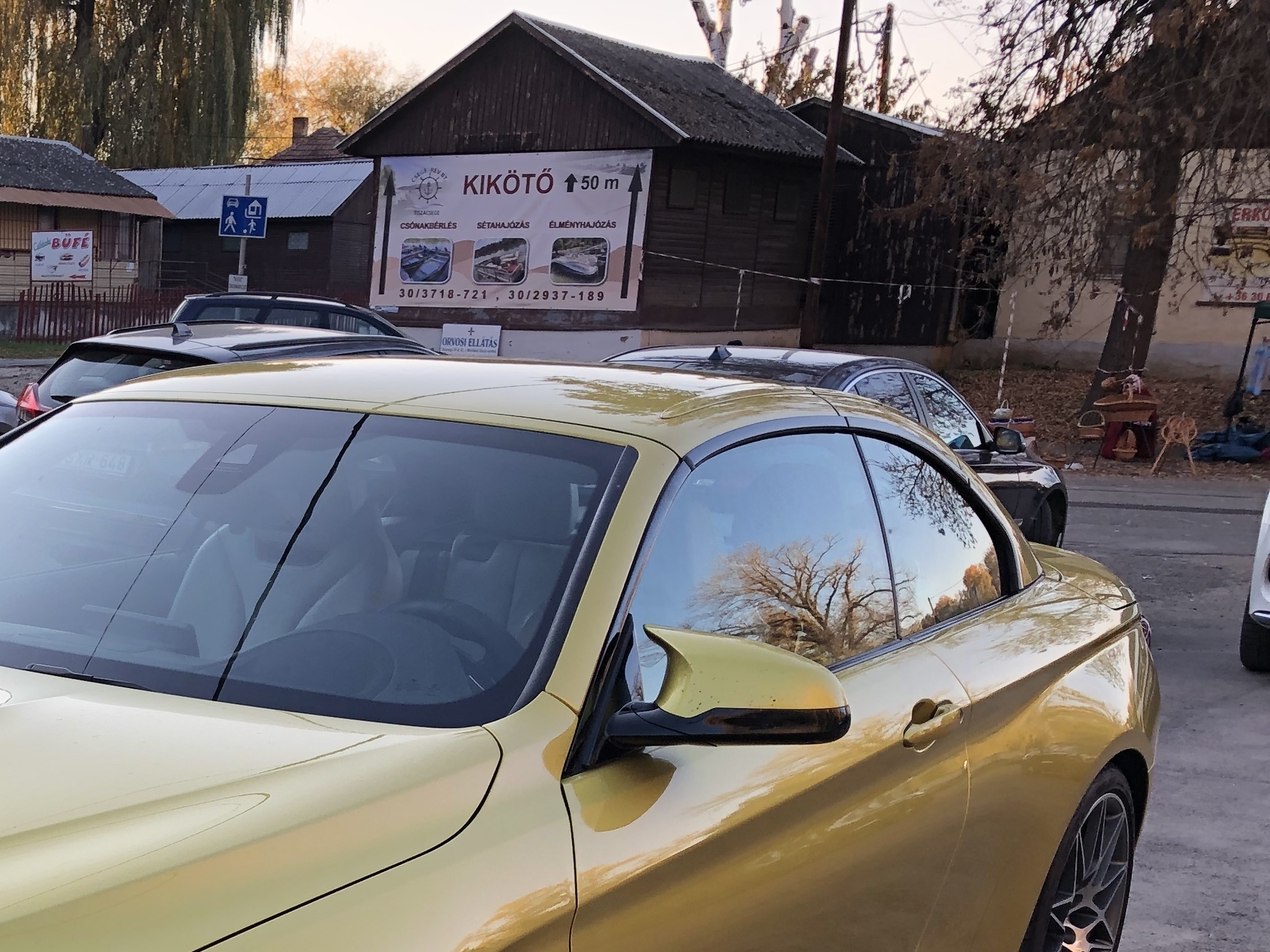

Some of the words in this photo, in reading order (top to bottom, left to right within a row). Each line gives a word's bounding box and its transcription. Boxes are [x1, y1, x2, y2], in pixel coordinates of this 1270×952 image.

[462, 168, 554, 195] KIKÖTŐ
[581, 175, 599, 190] 50
[604, 178, 619, 189] m
[400, 221, 458, 230] CSÓNAKBÉRLÉS
[476, 219, 530, 229] SÉTAHAJÓZÁS
[548, 219, 617, 229] ÉLMÉNYHAJÓZÁS
[51, 233, 90, 249] BÜFÉ
[398, 288, 487, 300] 30/3718-721
[508, 289, 605, 302] 30/2937-189
[442, 337, 467, 347] ORVOSI
[468, 336, 498, 348] ELLÁTÁS
